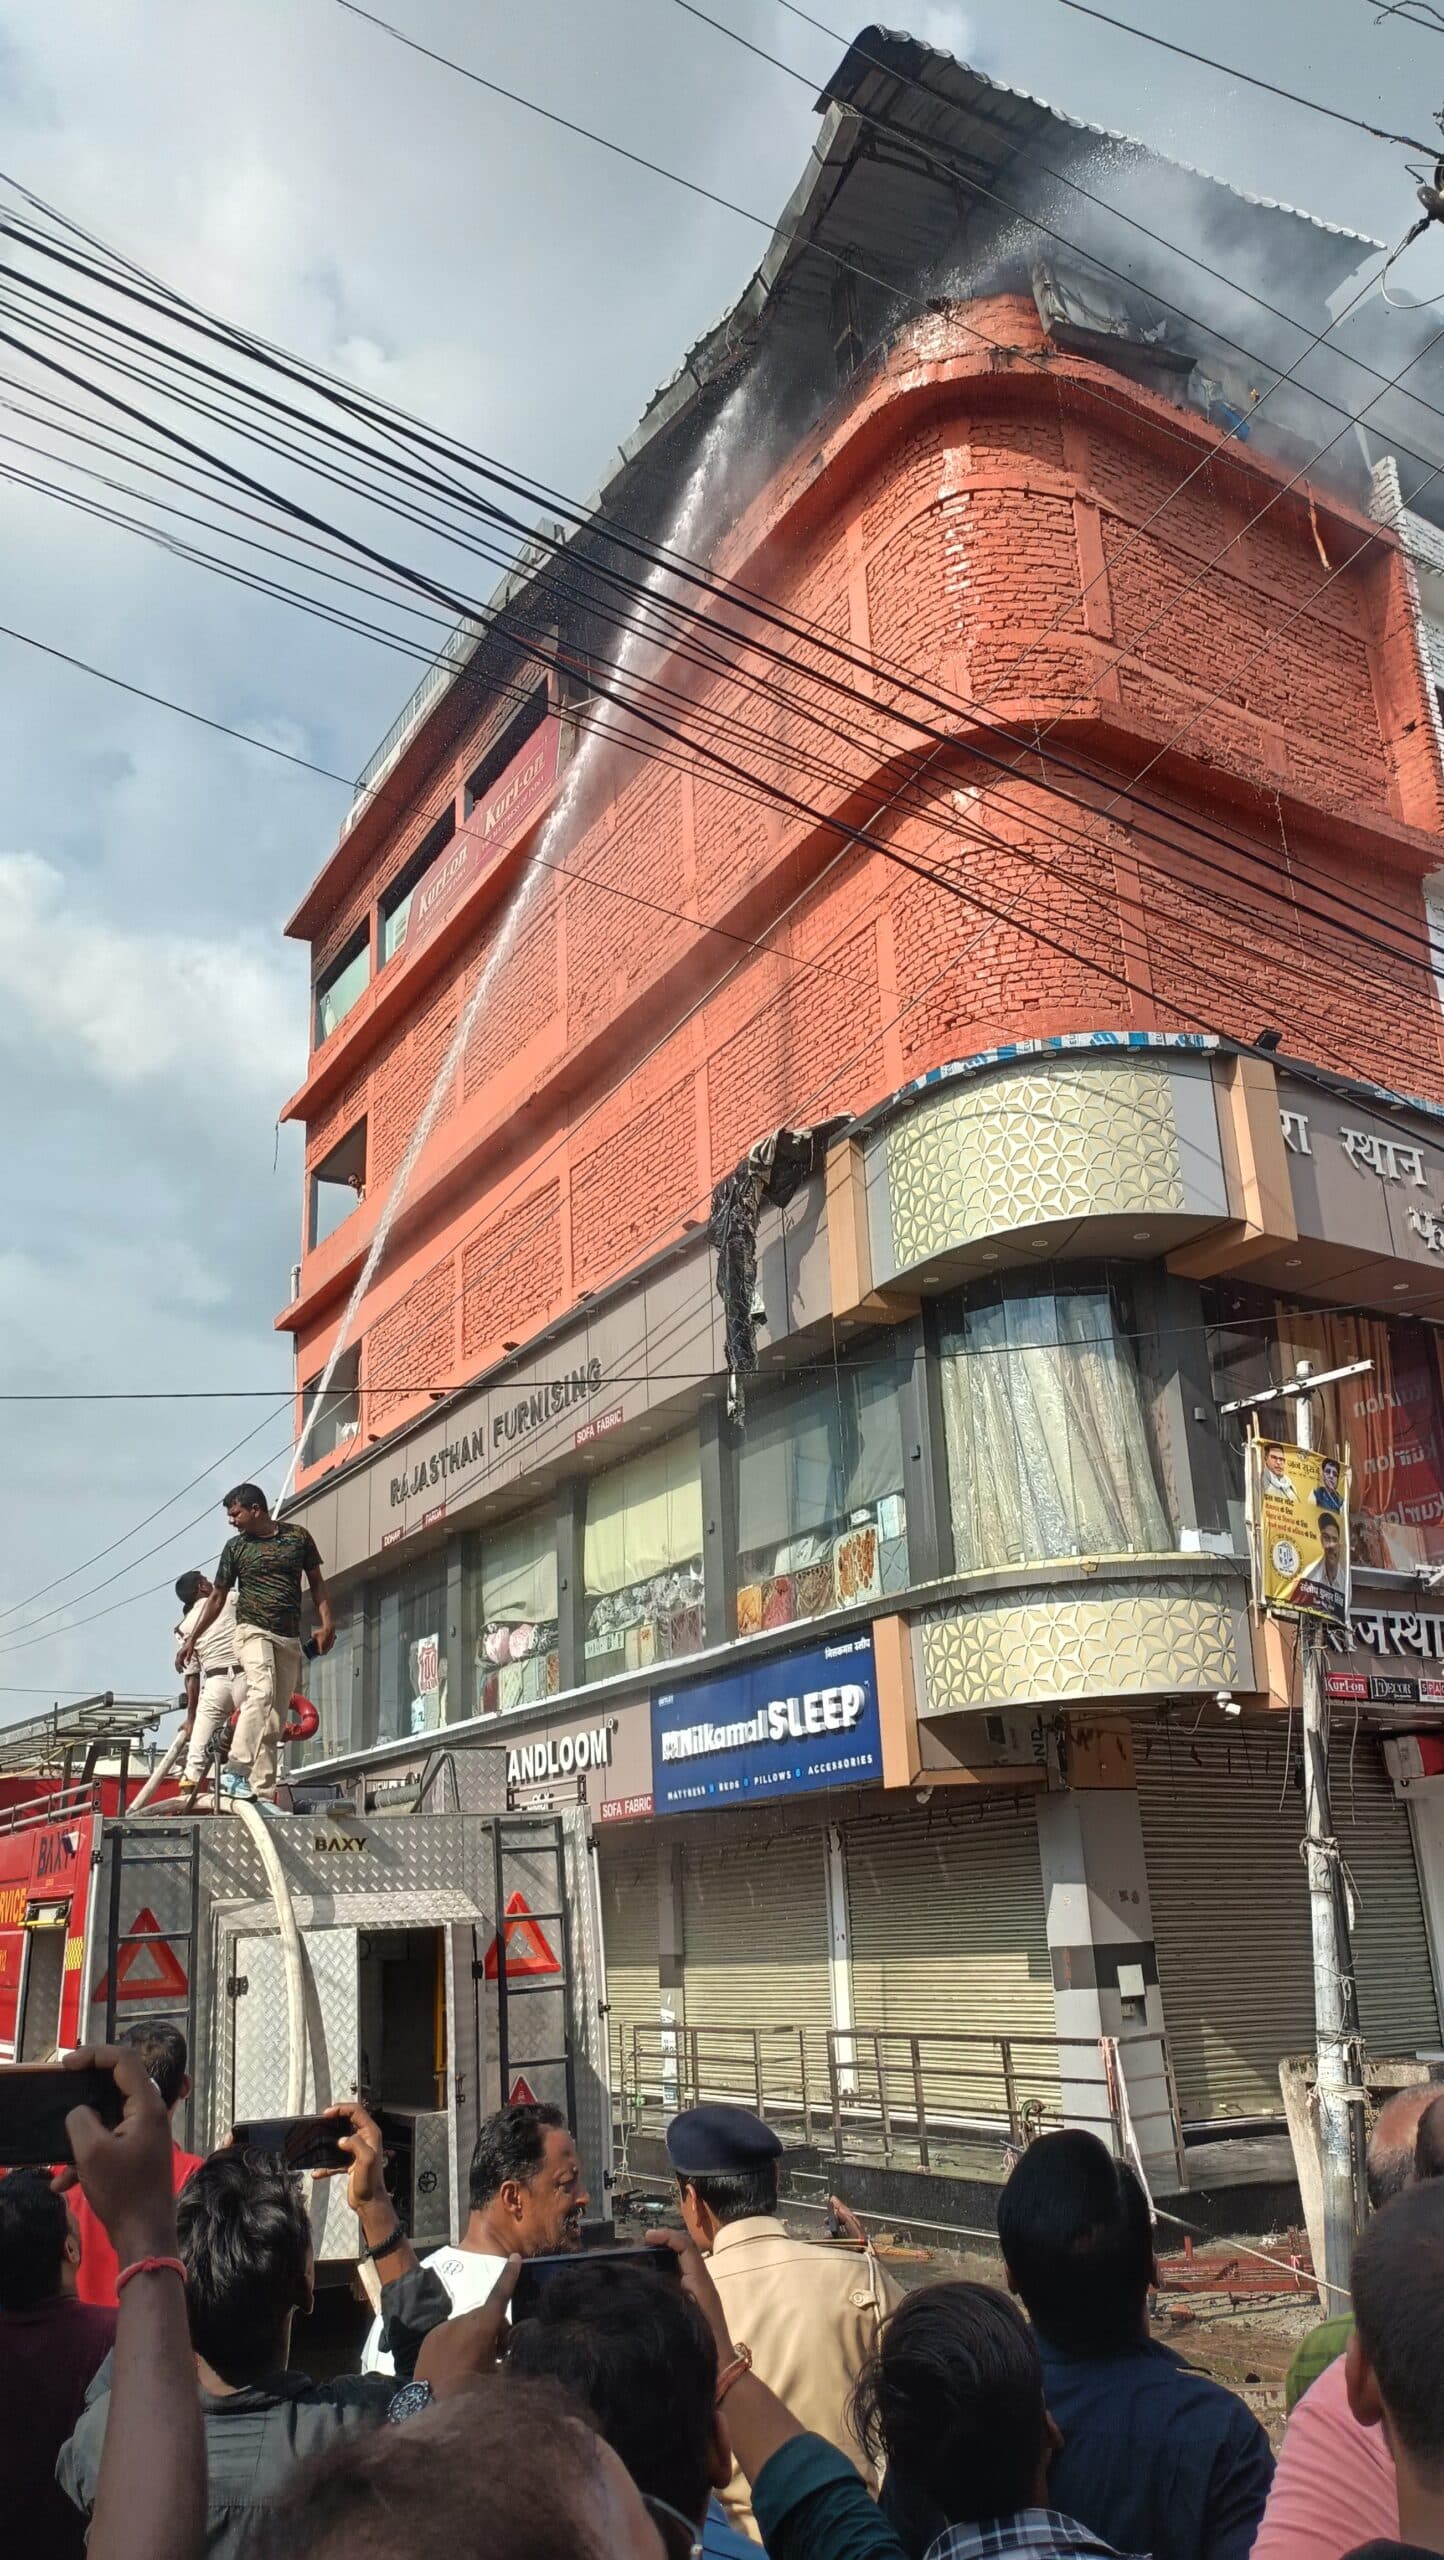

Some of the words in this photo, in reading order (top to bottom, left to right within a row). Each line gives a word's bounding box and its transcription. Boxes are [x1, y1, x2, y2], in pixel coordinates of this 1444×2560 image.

[1339, 1126, 1428, 1186] स्थान
[389, 1427, 485, 1507] RAJASTHAN
[493, 1357, 603, 1448] FURNISING
[576, 1427, 595, 1444] SOFA
[596, 1409, 622, 1434] FABRIC
[667, 1785, 706, 1800] MATTRESS
[718, 1779, 740, 1792] BEDS
[754, 1770, 792, 1785] PILLOWS
[808, 1754, 873, 1776] ACCESSORIES
[602, 1802, 622, 1818] SOFA
[624, 1796, 652, 1815] FABRIC
[314, 1836, 368, 1852] BAXY
